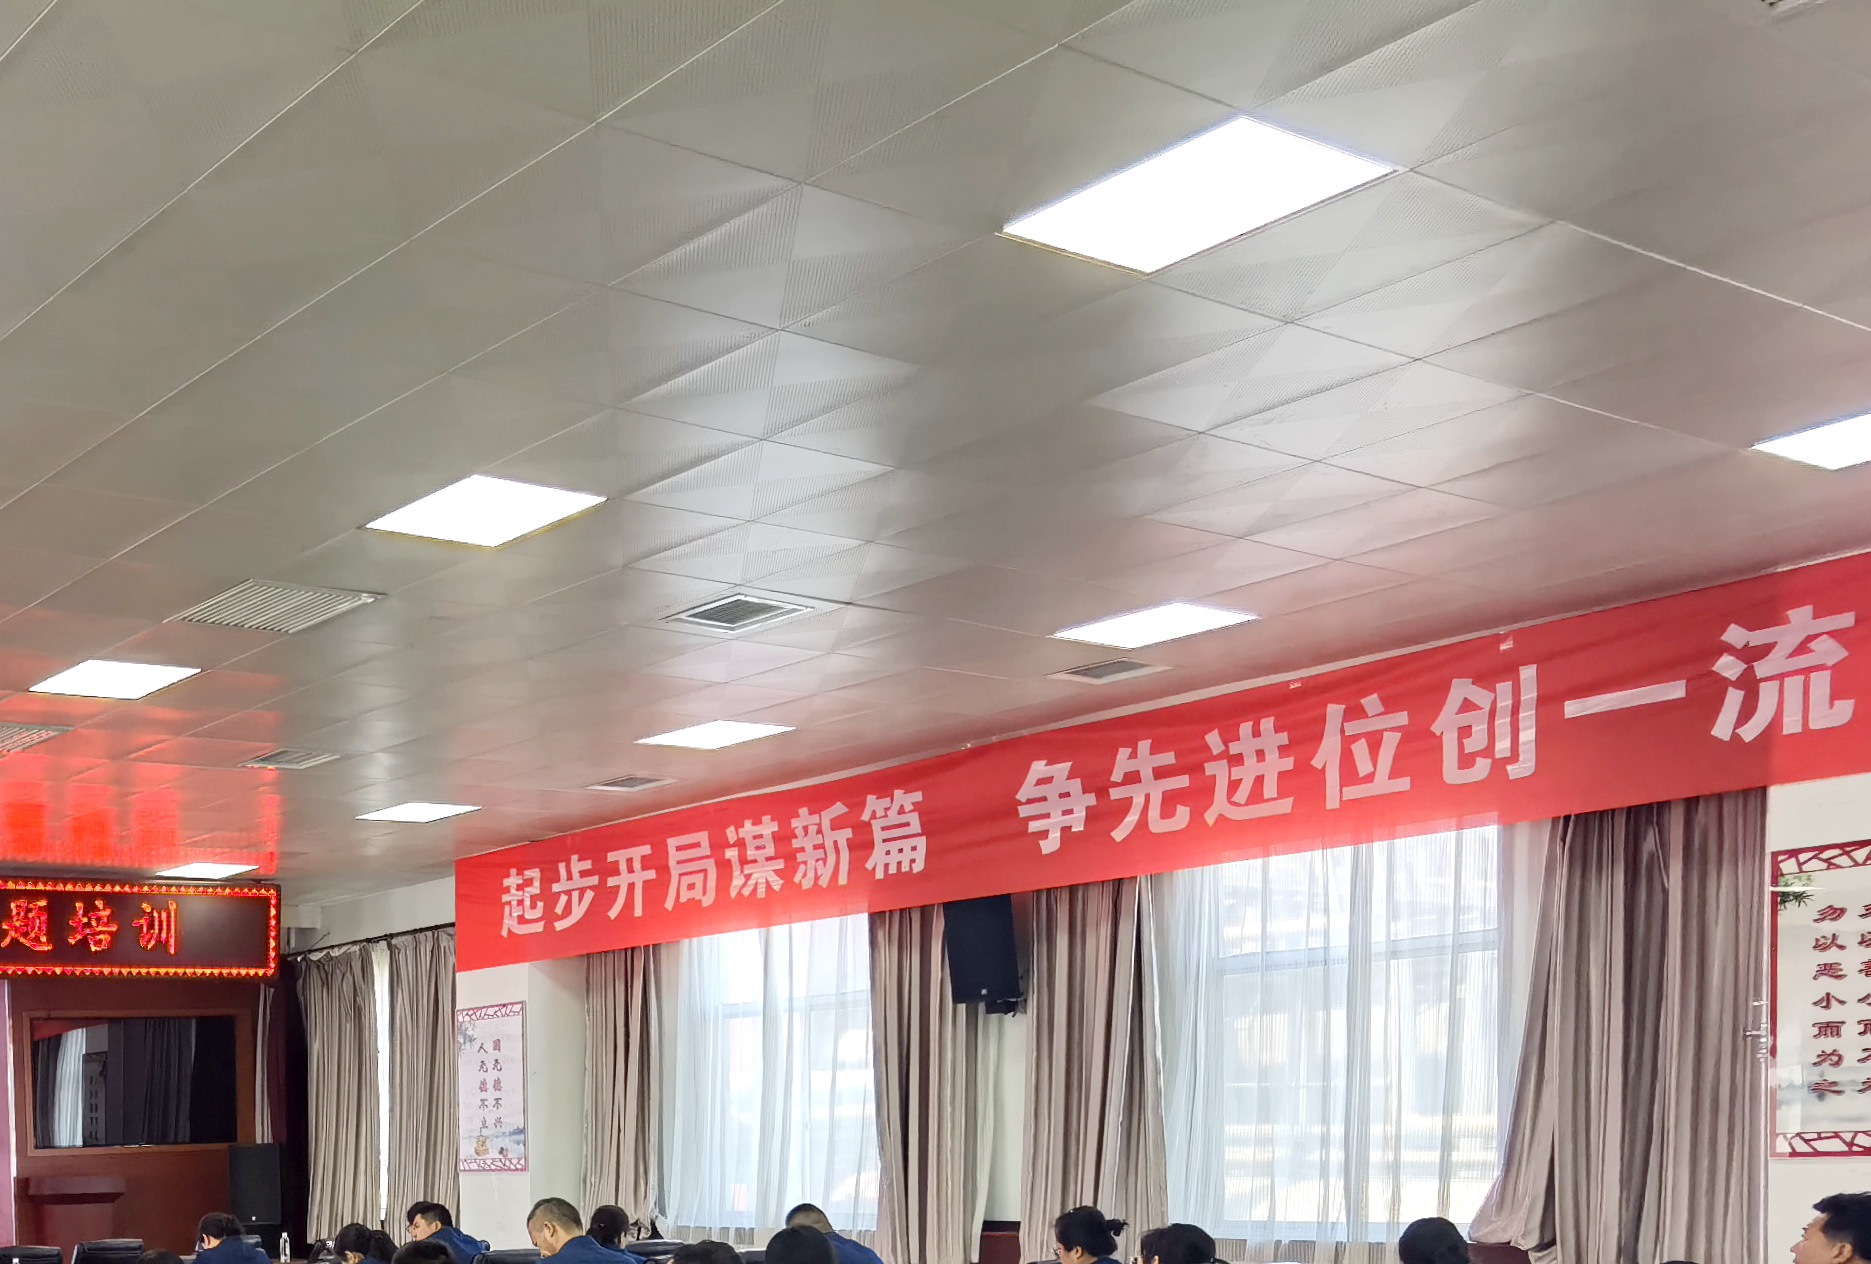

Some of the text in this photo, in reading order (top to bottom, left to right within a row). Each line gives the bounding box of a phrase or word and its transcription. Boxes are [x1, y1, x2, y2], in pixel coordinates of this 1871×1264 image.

[499, 604, 1857, 939] 起步开局谋新篇 争先进位创一流
[478, 1042, 489, 1129] 人无德不立
[492, 1038, 503, 1129] 国无德不兴
